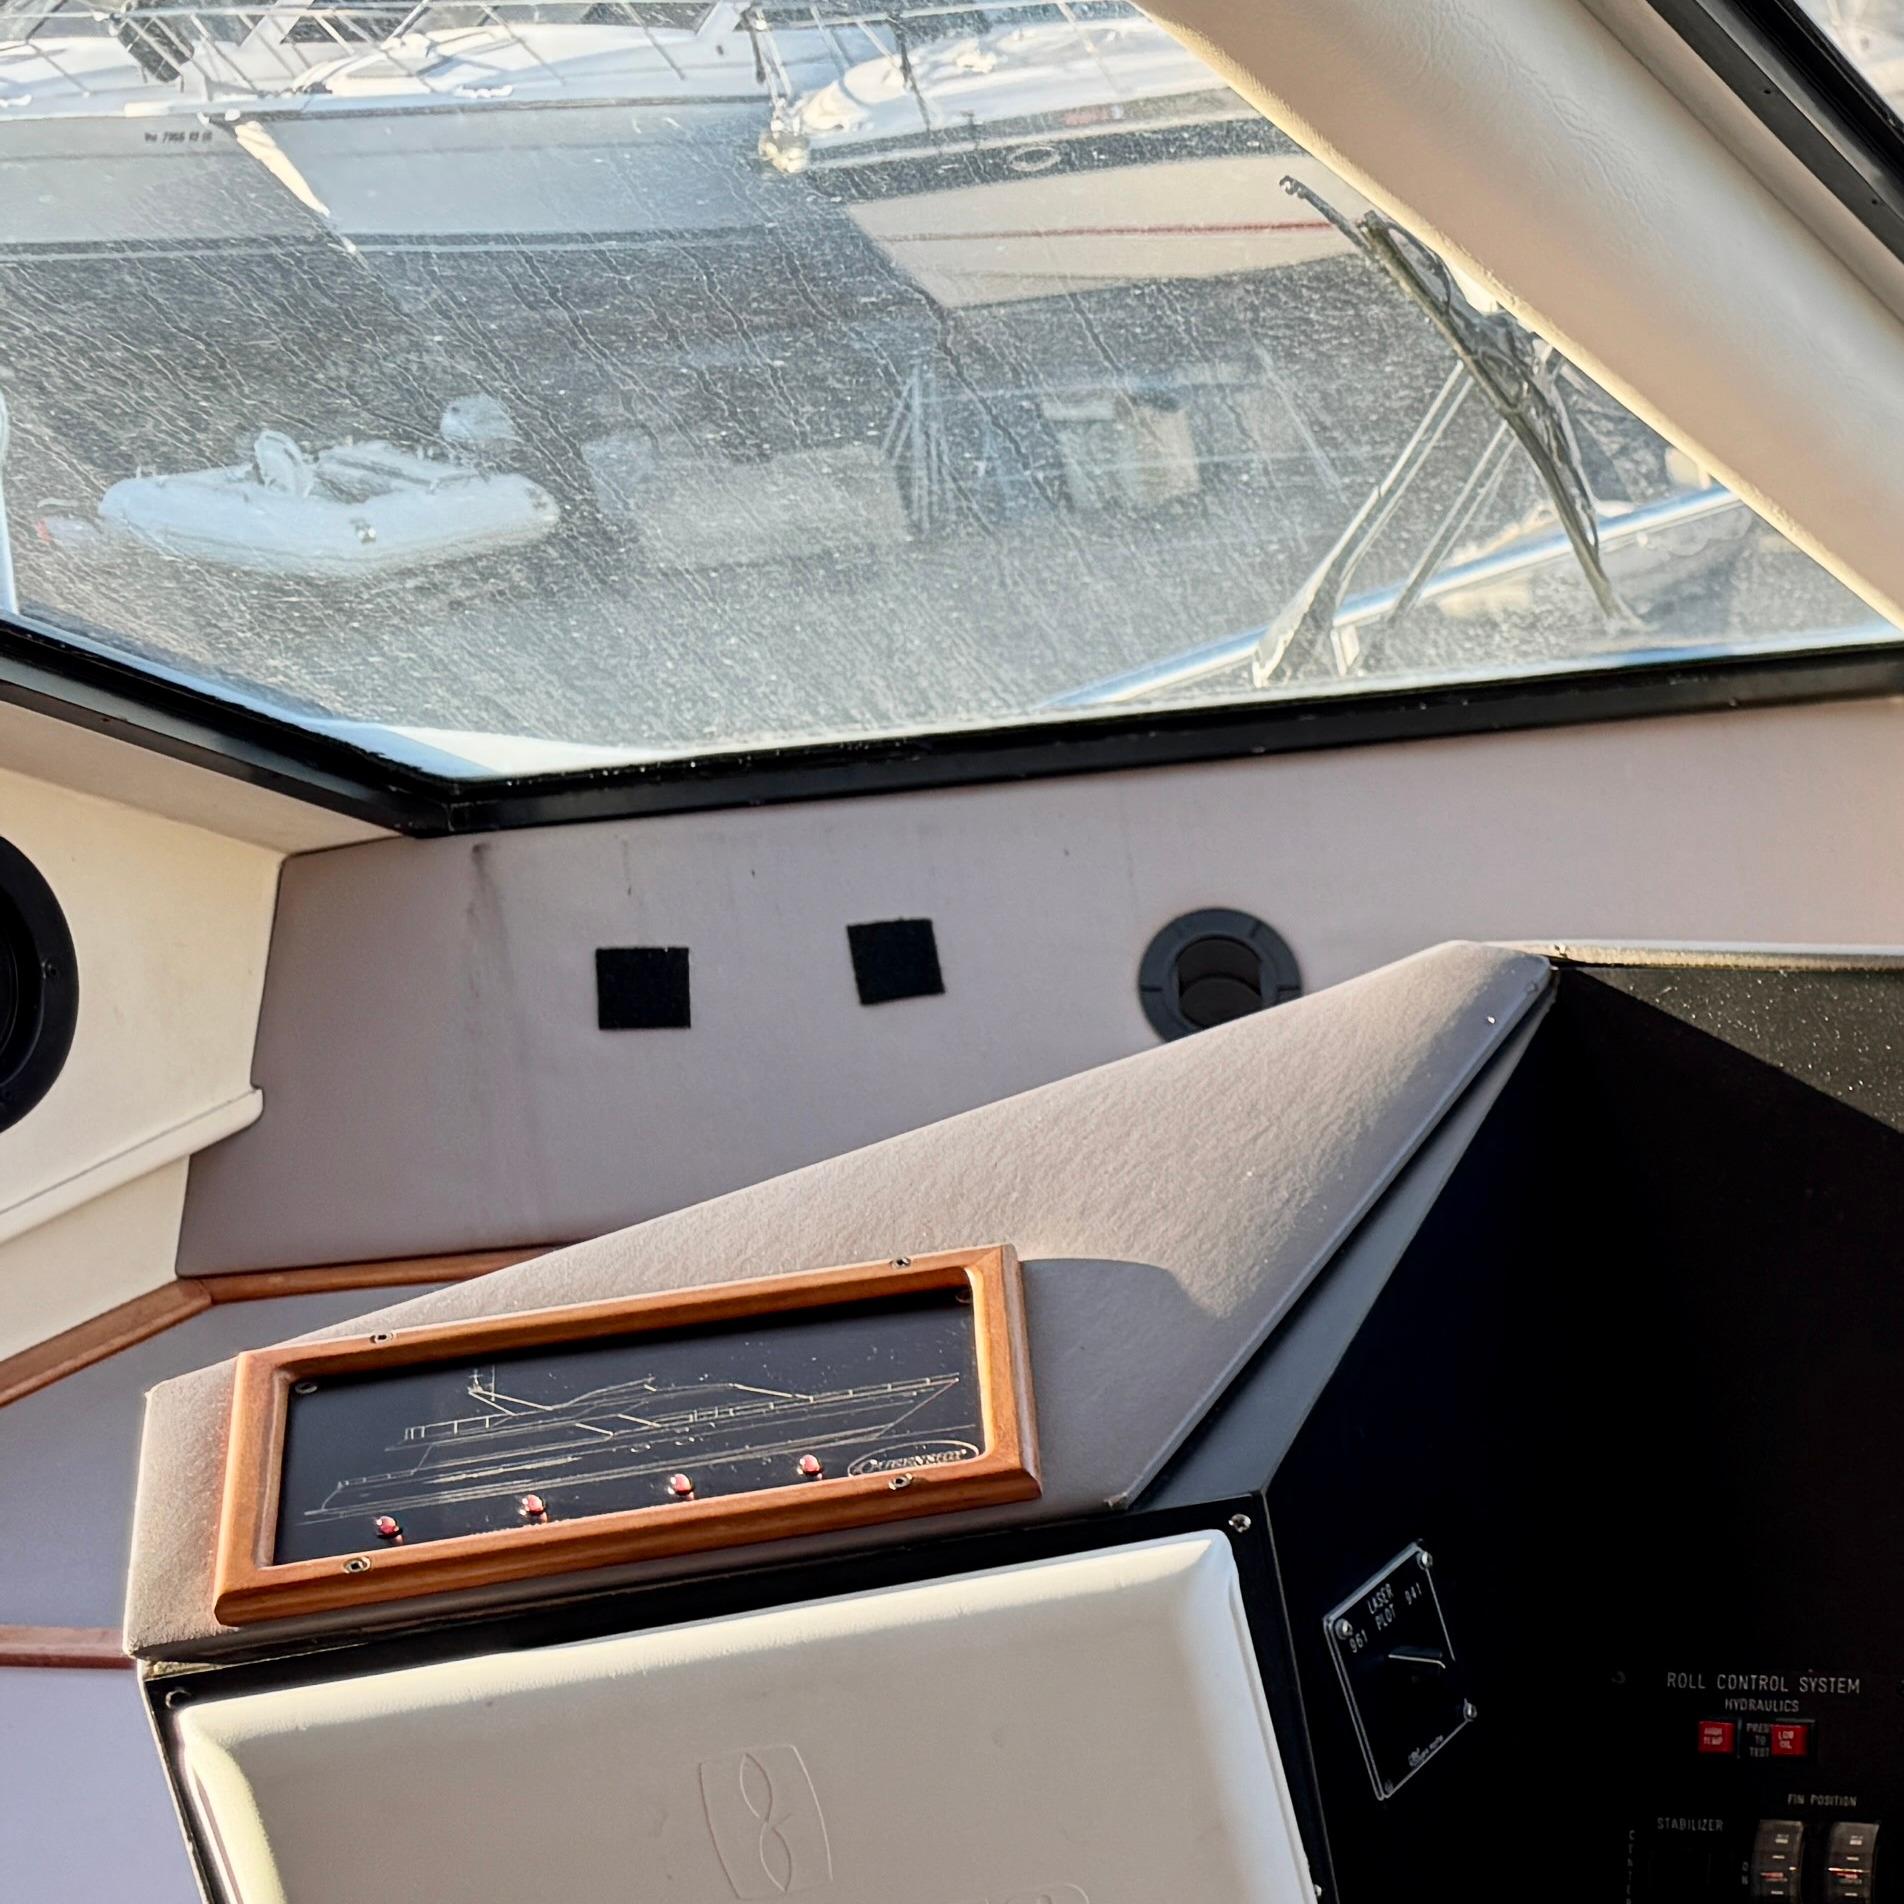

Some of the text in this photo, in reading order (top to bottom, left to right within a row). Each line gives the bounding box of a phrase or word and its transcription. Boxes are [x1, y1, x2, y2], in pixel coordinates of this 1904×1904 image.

[1666, 1671, 1862, 1695] ROLL CONTROL SYSTEM
[1724, 1698, 1801, 1714] HYDRAULICS
[1787, 1793, 1858, 1808] FIN POSITION
[1656, 1817, 1725, 1833] STABILIZER
